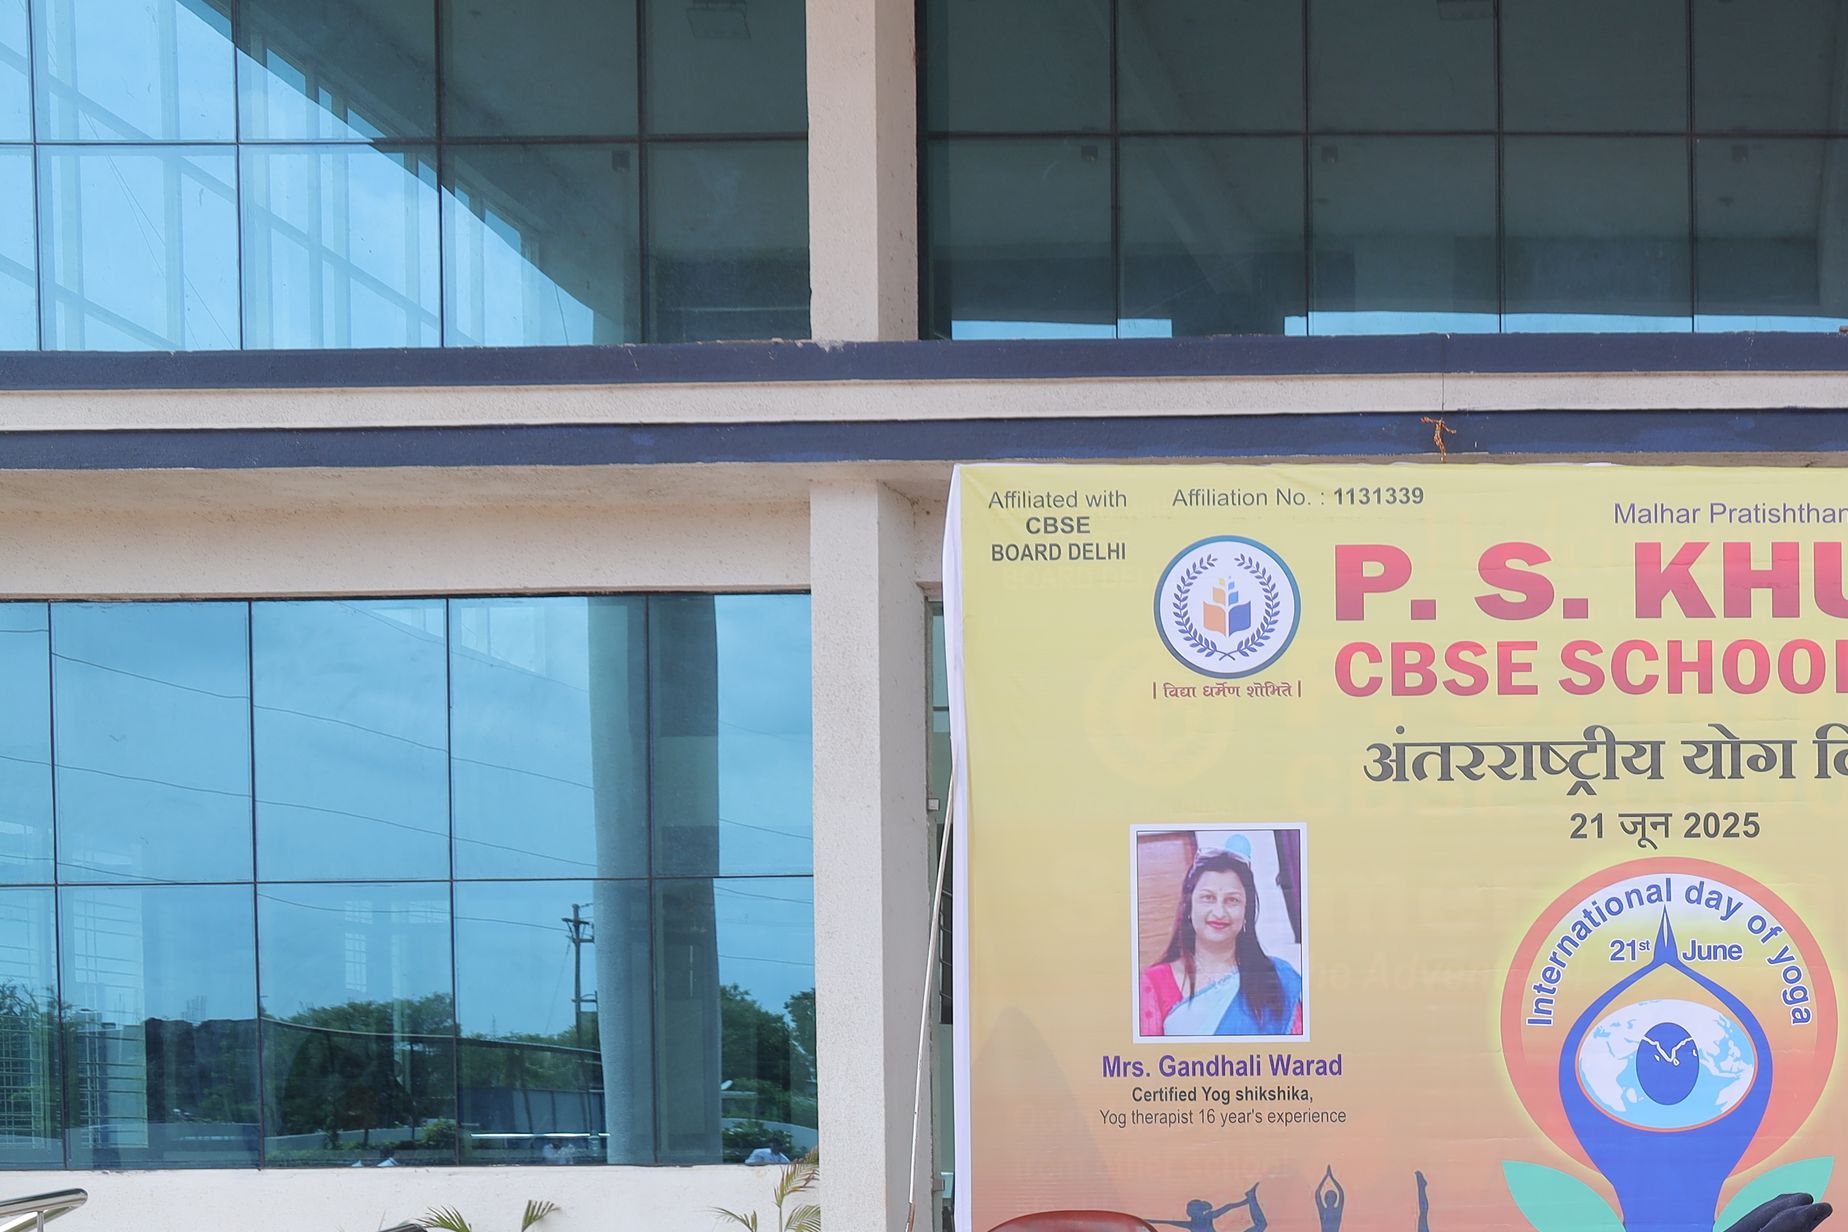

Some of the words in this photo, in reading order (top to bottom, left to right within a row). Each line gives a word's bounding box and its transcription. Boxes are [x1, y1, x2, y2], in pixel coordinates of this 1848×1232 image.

[988, 490, 1079, 509] Affiliated
[1084, 489, 1128, 508] with
[1171, 487, 1268, 508] Affiliation
[1275, 488, 1312, 507] No.
[1333, 486, 1425, 506] 1131339
[1613, 502, 1701, 524] Malhar
[1025, 515, 1091, 535] CBSE
[991, 543, 1062, 563] BOARD
[1068, 542, 1126, 562] DELHI
[1335, 544, 1437, 622] P.
[1474, 541, 1589, 621] S.
[1334, 641, 1539, 698] CBSE
[1163, 682, 1197, 699] विद्या
[1246, 681, 1293, 698] शोभिते
[1363, 722, 1667, 797] अंतरराष्ट्रीय
[1680, 722, 1798, 781] योग
[1569, 812, 1605, 840] 21
[1618, 812, 1673, 850] जून
[1683, 811, 1761, 839] 2025
[1526, 876, 1673, 1027] International
[1684, 880, 1744, 923] day
[1746, 912, 1784, 946] of
[1766, 944, 1814, 1026] yoga
[1682, 939, 1744, 962] June
[1102, 1055, 1152, 1078] Mrs.
[1158, 1054, 1262, 1078] Gandhali
[1268, 1053, 1343, 1077] Warad
[1132, 1086, 1197, 1103] Certified
[1202, 1086, 1230, 1105] Yog
[1235, 1085, 1314, 1104] shikshika,
[1099, 1109, 1127, 1128] Yog
[1131, 1108, 1194, 1128] therapist
[1198, 1109, 1216, 1125] 16
[1220, 1108, 1263, 1128] year's
[1267, 1108, 1347, 1127] experience
